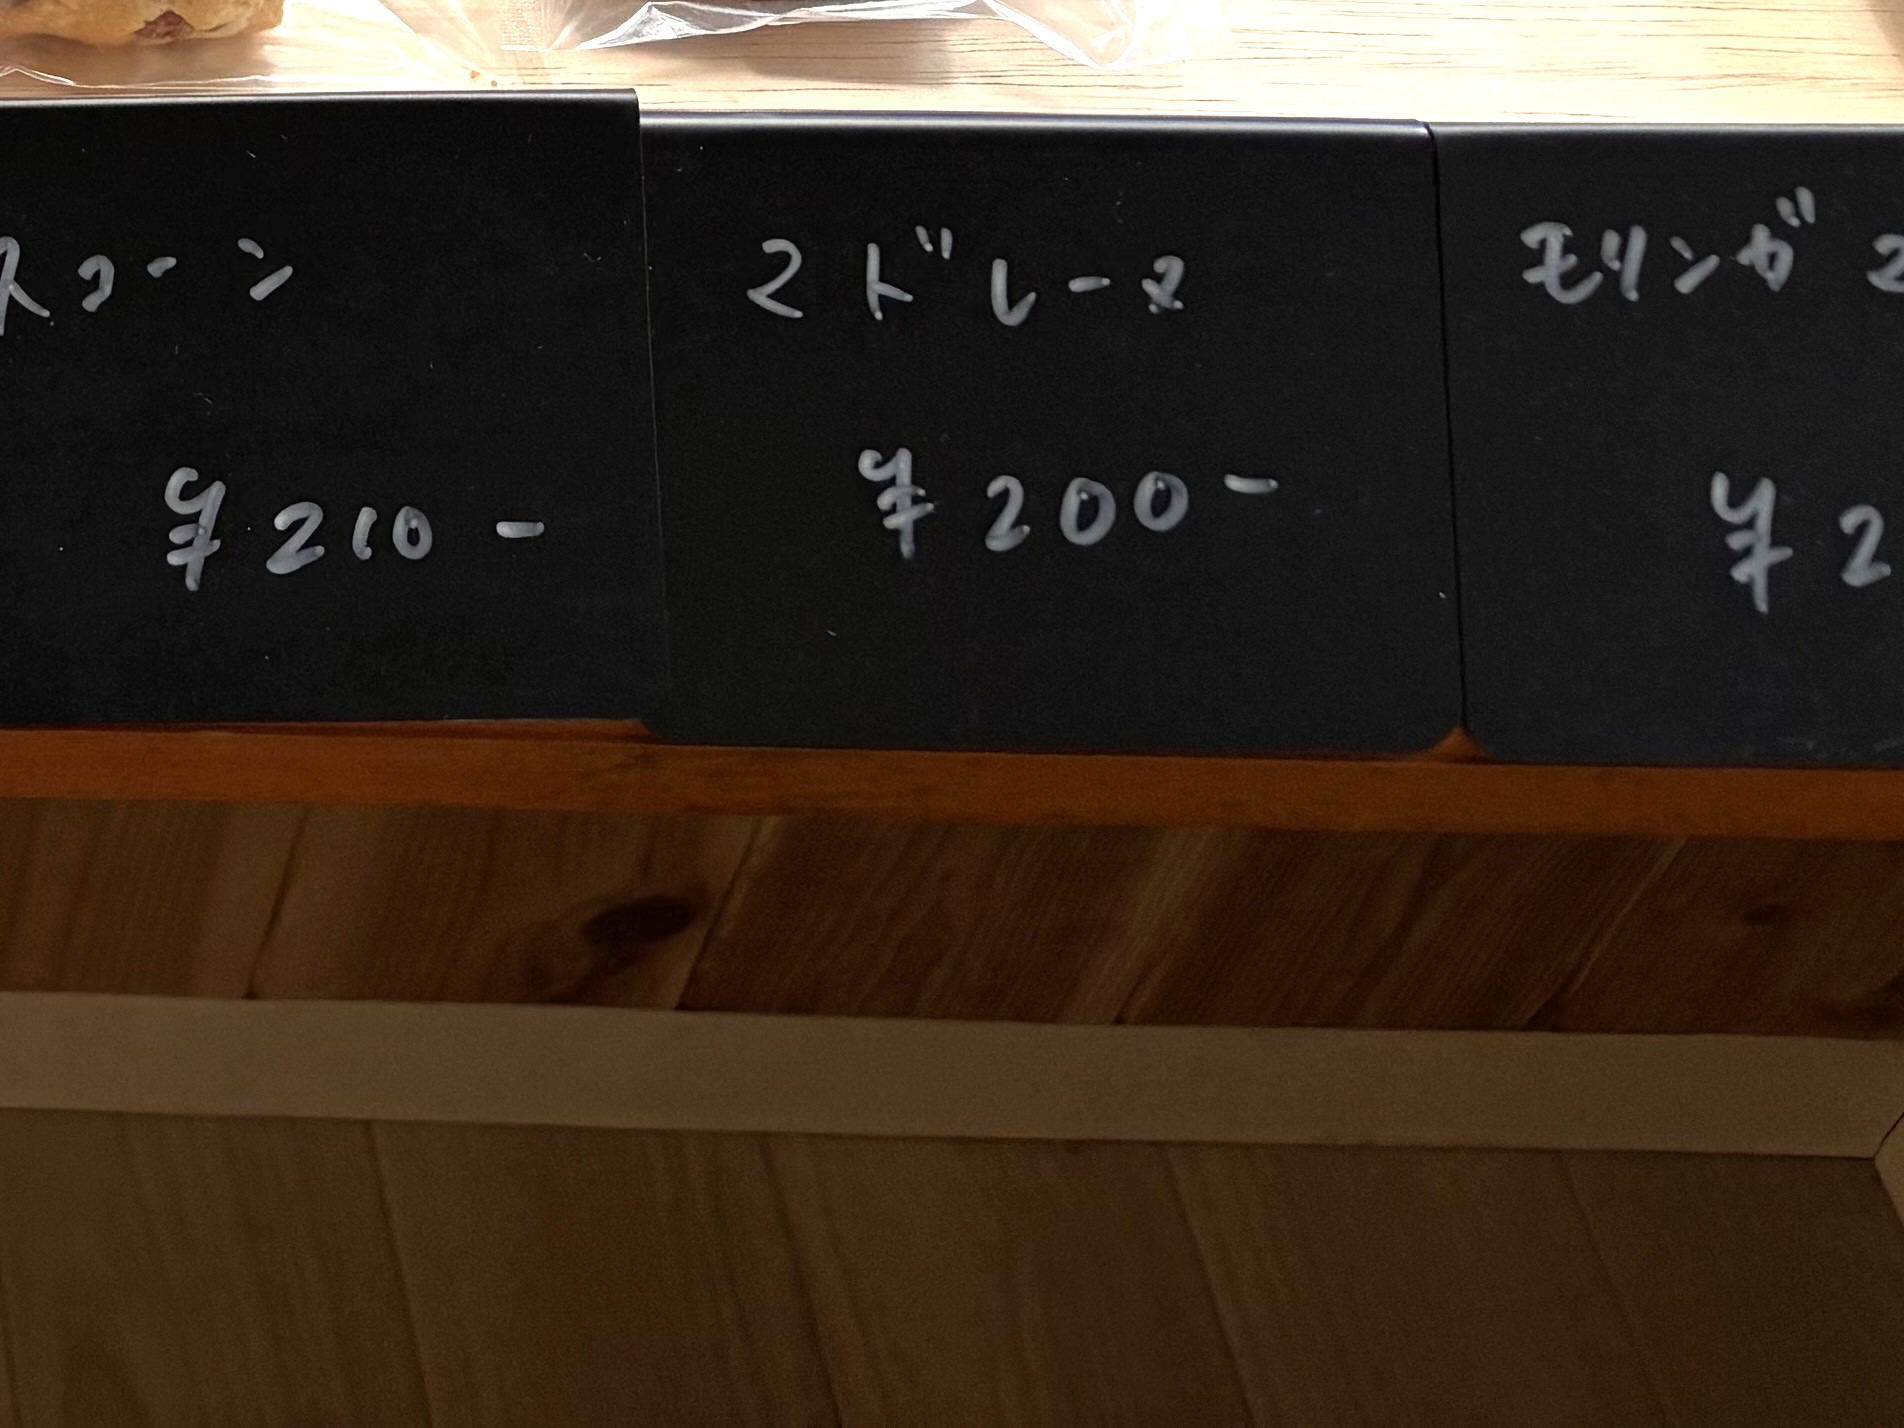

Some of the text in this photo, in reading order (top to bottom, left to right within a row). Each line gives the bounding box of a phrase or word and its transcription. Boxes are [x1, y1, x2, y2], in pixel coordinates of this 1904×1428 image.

[747, 224, 1185, 327] マドレーヌ
[1520, 186, 1816, 305] モリンガ
